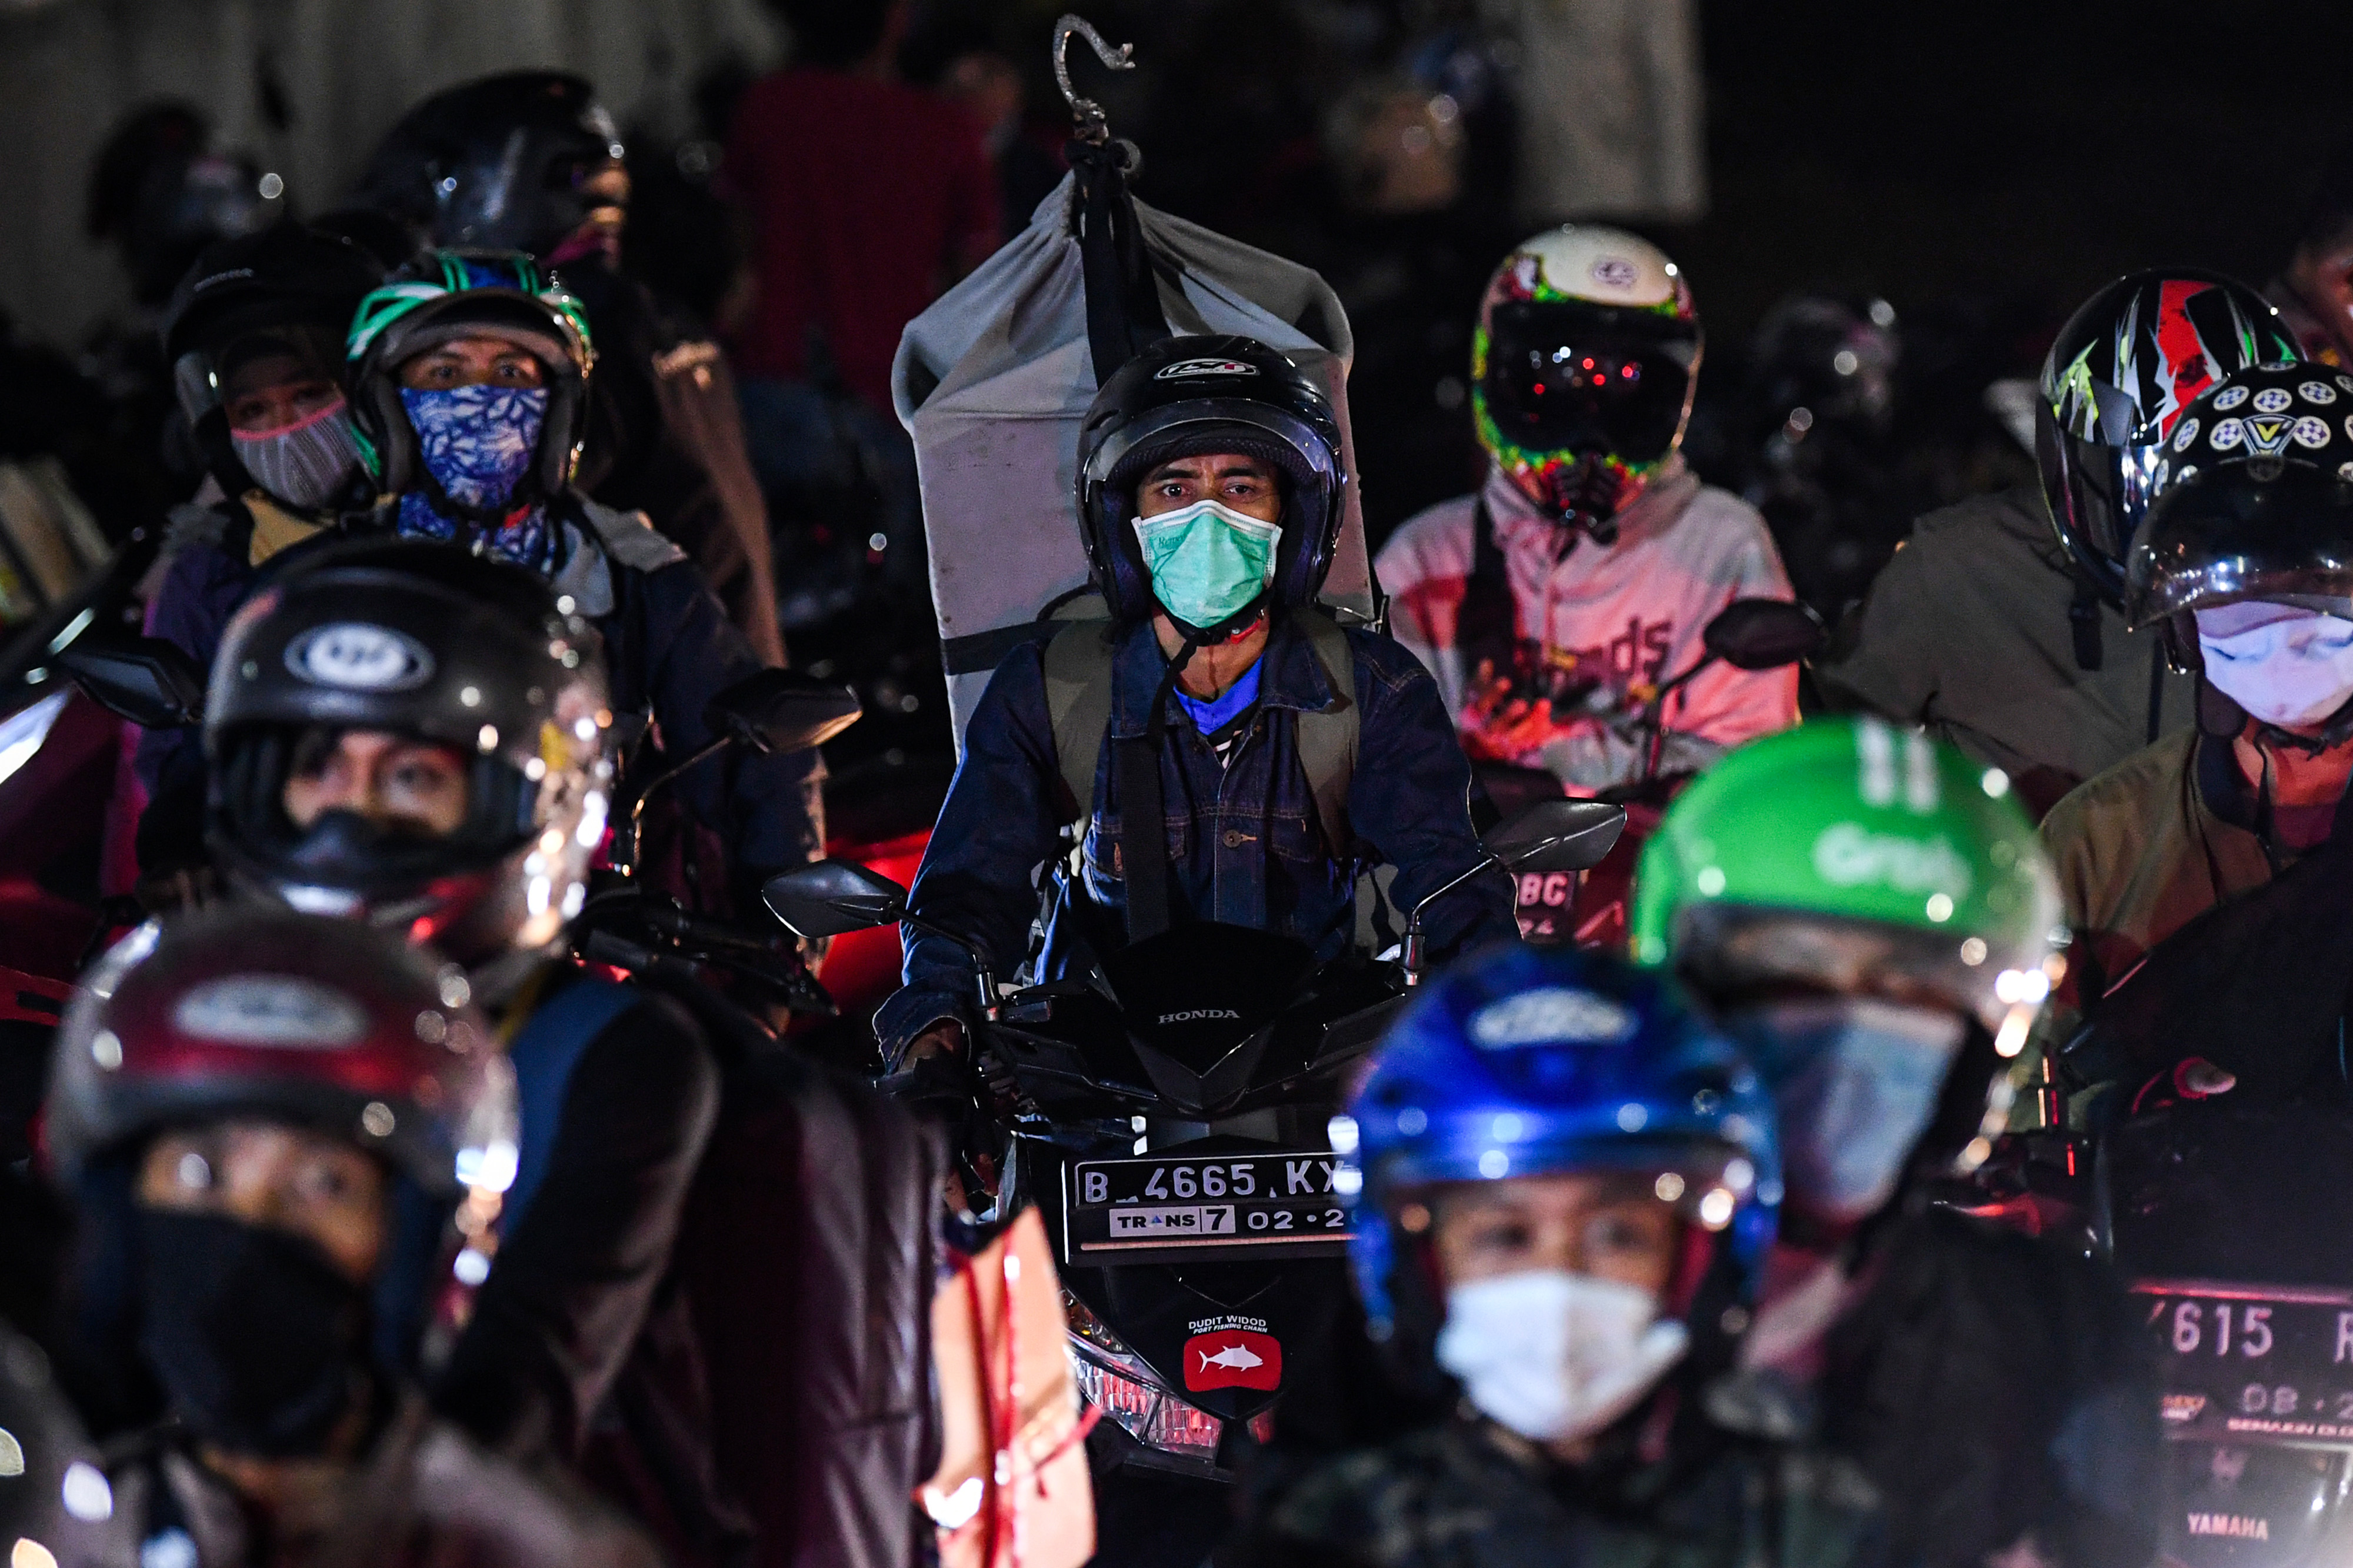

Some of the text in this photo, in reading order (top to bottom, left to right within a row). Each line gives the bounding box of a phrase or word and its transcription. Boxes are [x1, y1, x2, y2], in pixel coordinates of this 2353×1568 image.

[1158, 1009, 1241, 1025] HONDA
[1085, 1172, 1108, 1203] B
[1145, 1164, 1255, 1200] 4665
[1207, 1209, 1227, 1230] 7
[1188, 1315, 1267, 1330] DUDIT WIDOD
[1213, 1323, 1242, 1331] FISHING
[2148, 1300, 2274, 1357] 615
[2188, 1513, 2268, 1541] YAMAHA
